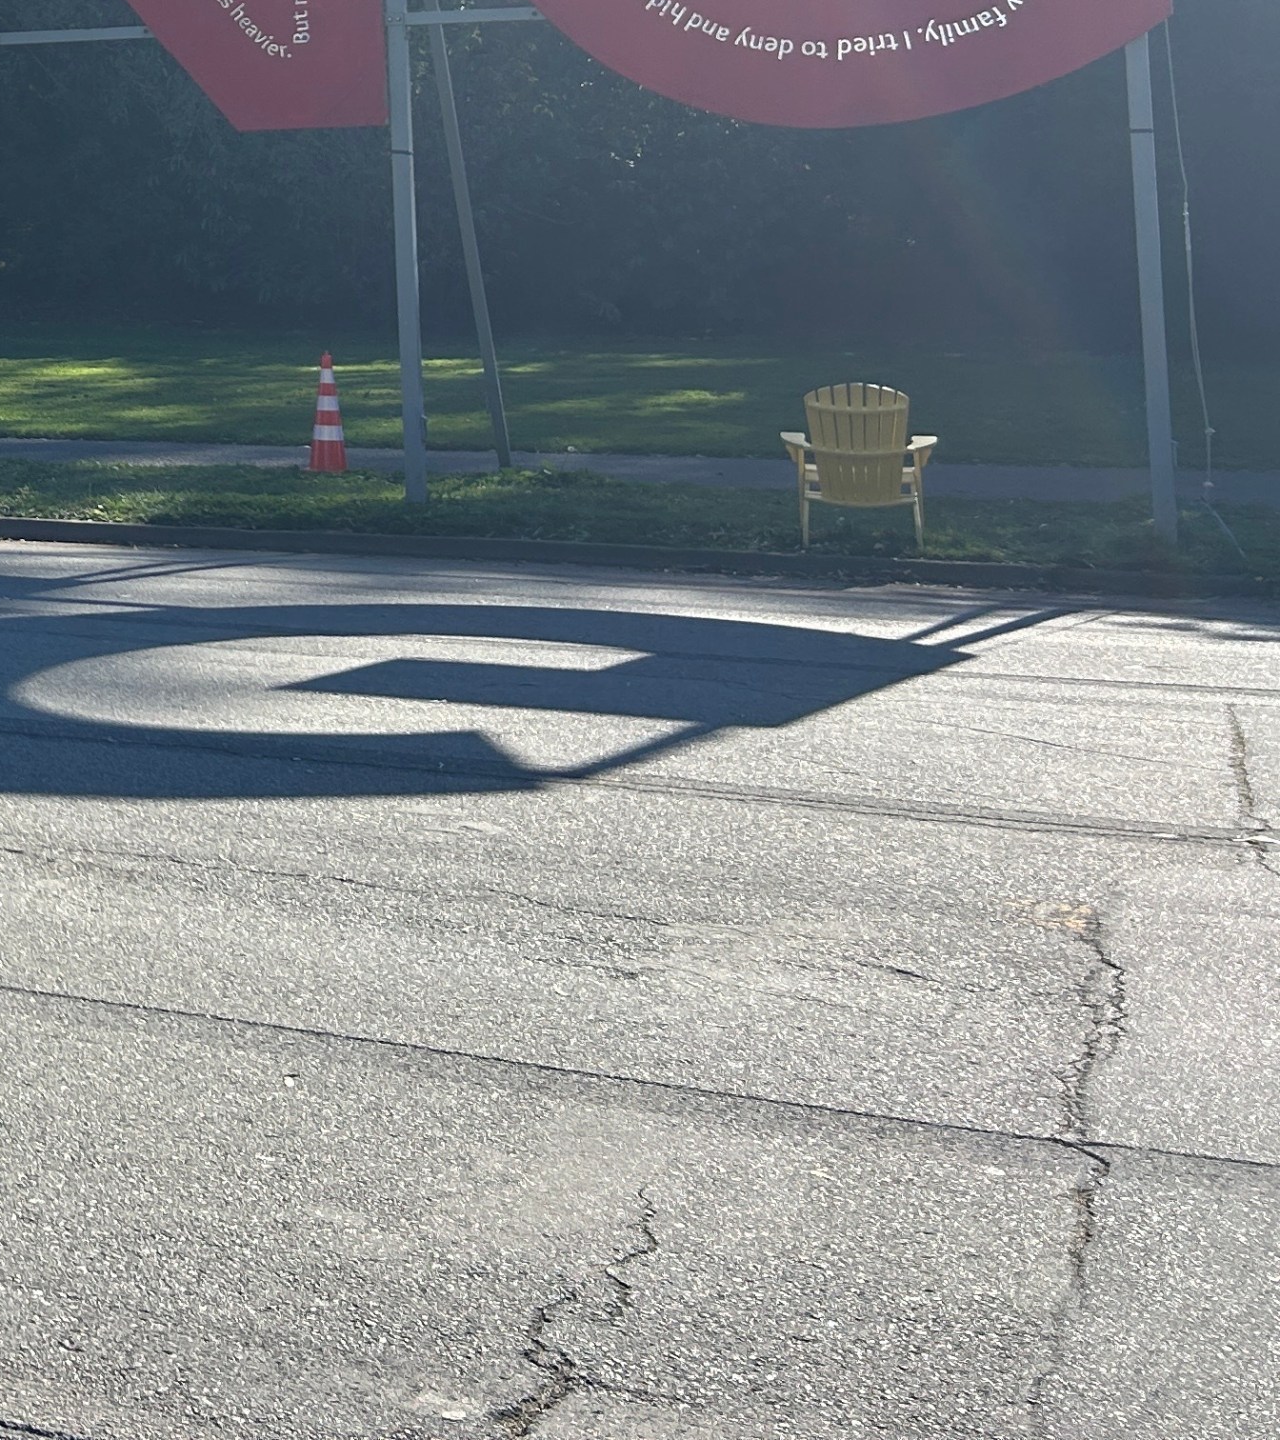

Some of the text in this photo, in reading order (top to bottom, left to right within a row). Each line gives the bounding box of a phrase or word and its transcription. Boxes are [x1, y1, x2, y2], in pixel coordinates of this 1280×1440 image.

[229, 2, 292, 58] heavier.
[292, 9, 311, 44] But
[683, 12, 730, 42] and
[902, 30, 912, 50] I
[916, 6, 1007, 47] family.
[733, 26, 794, 60] deny
[800, 40, 829, 59] to
[836, 32, 899, 61] tried
